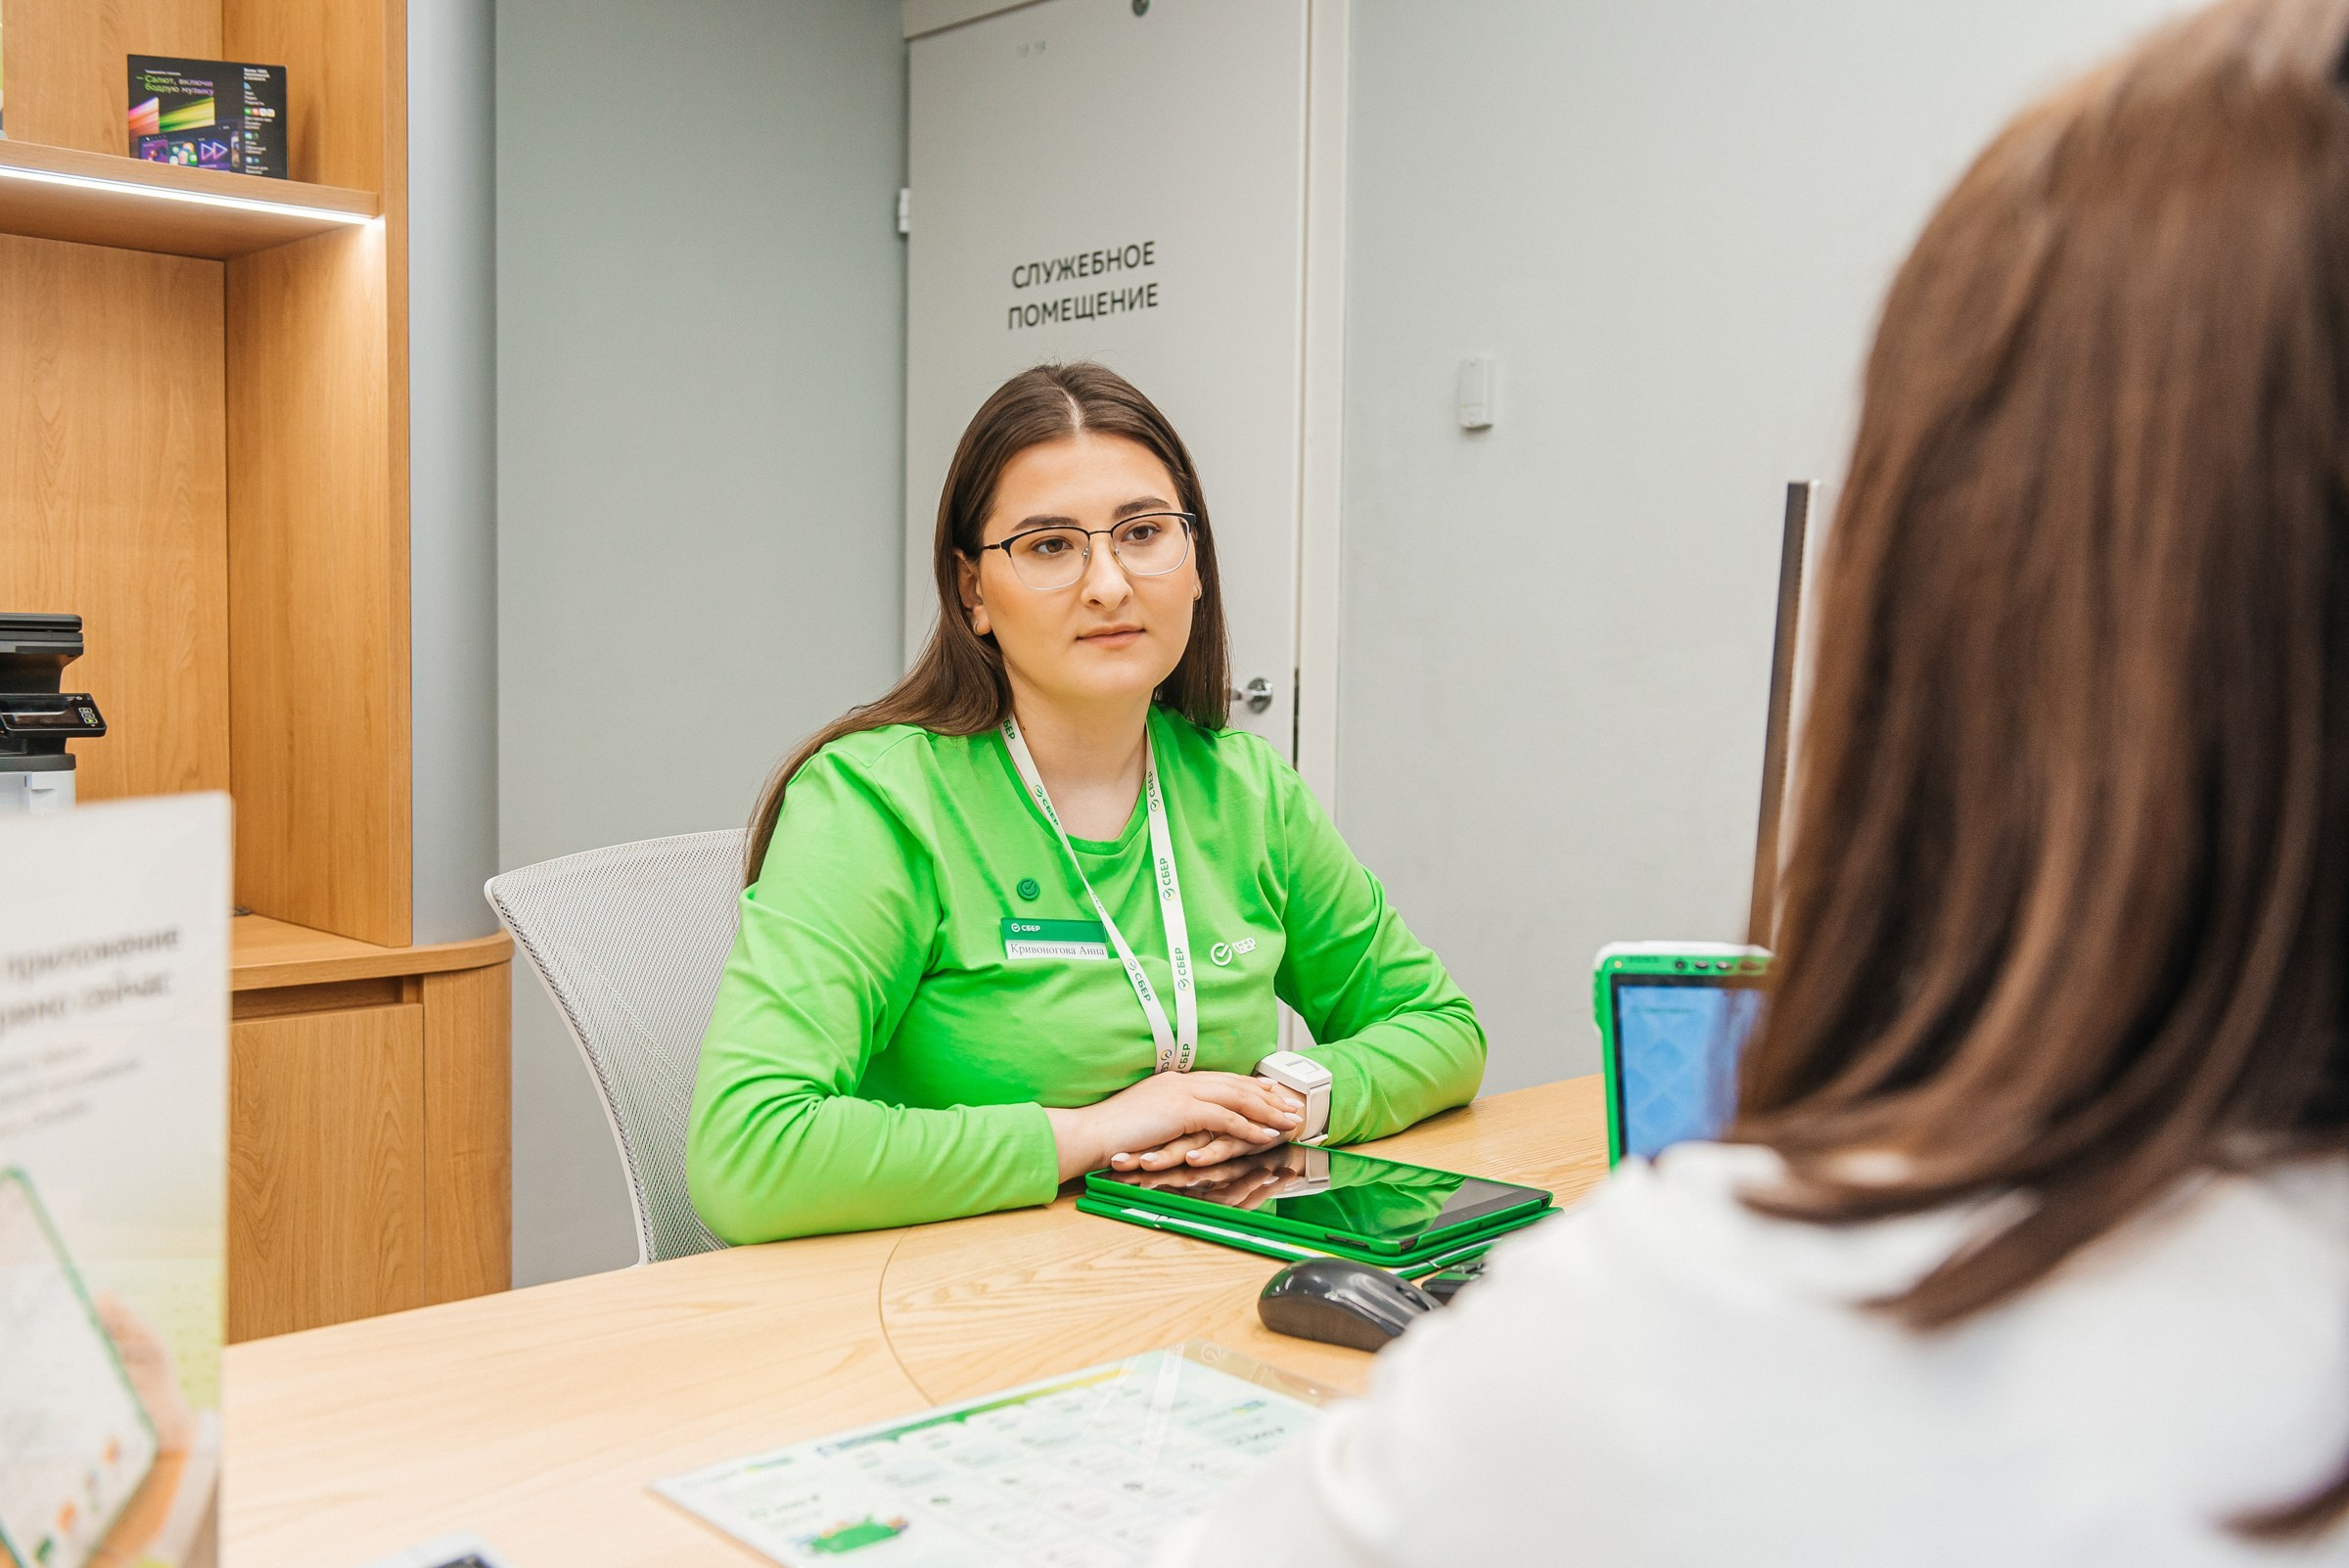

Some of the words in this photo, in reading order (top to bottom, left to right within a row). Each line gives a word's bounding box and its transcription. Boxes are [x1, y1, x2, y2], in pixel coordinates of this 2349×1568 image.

[1011, 241, 1155, 289] СЛУЖЕБНОЕ
[1008, 283, 1159, 330] ПОМЕЩЕНИЕ
[1003, 718, 1016, 740] БЕР
[1042, 799, 1059, 825] СБЕР
[1160, 857, 1172, 886] СБЕР
[1010, 943, 1077, 955] Кривоногова
[1079, 945, 1105, 955] Анна
[1174, 946, 1187, 976] СБЕР
[1134, 972, 1152, 1001] СБЕР
[1177, 1043, 1190, 1070] СБЕР
